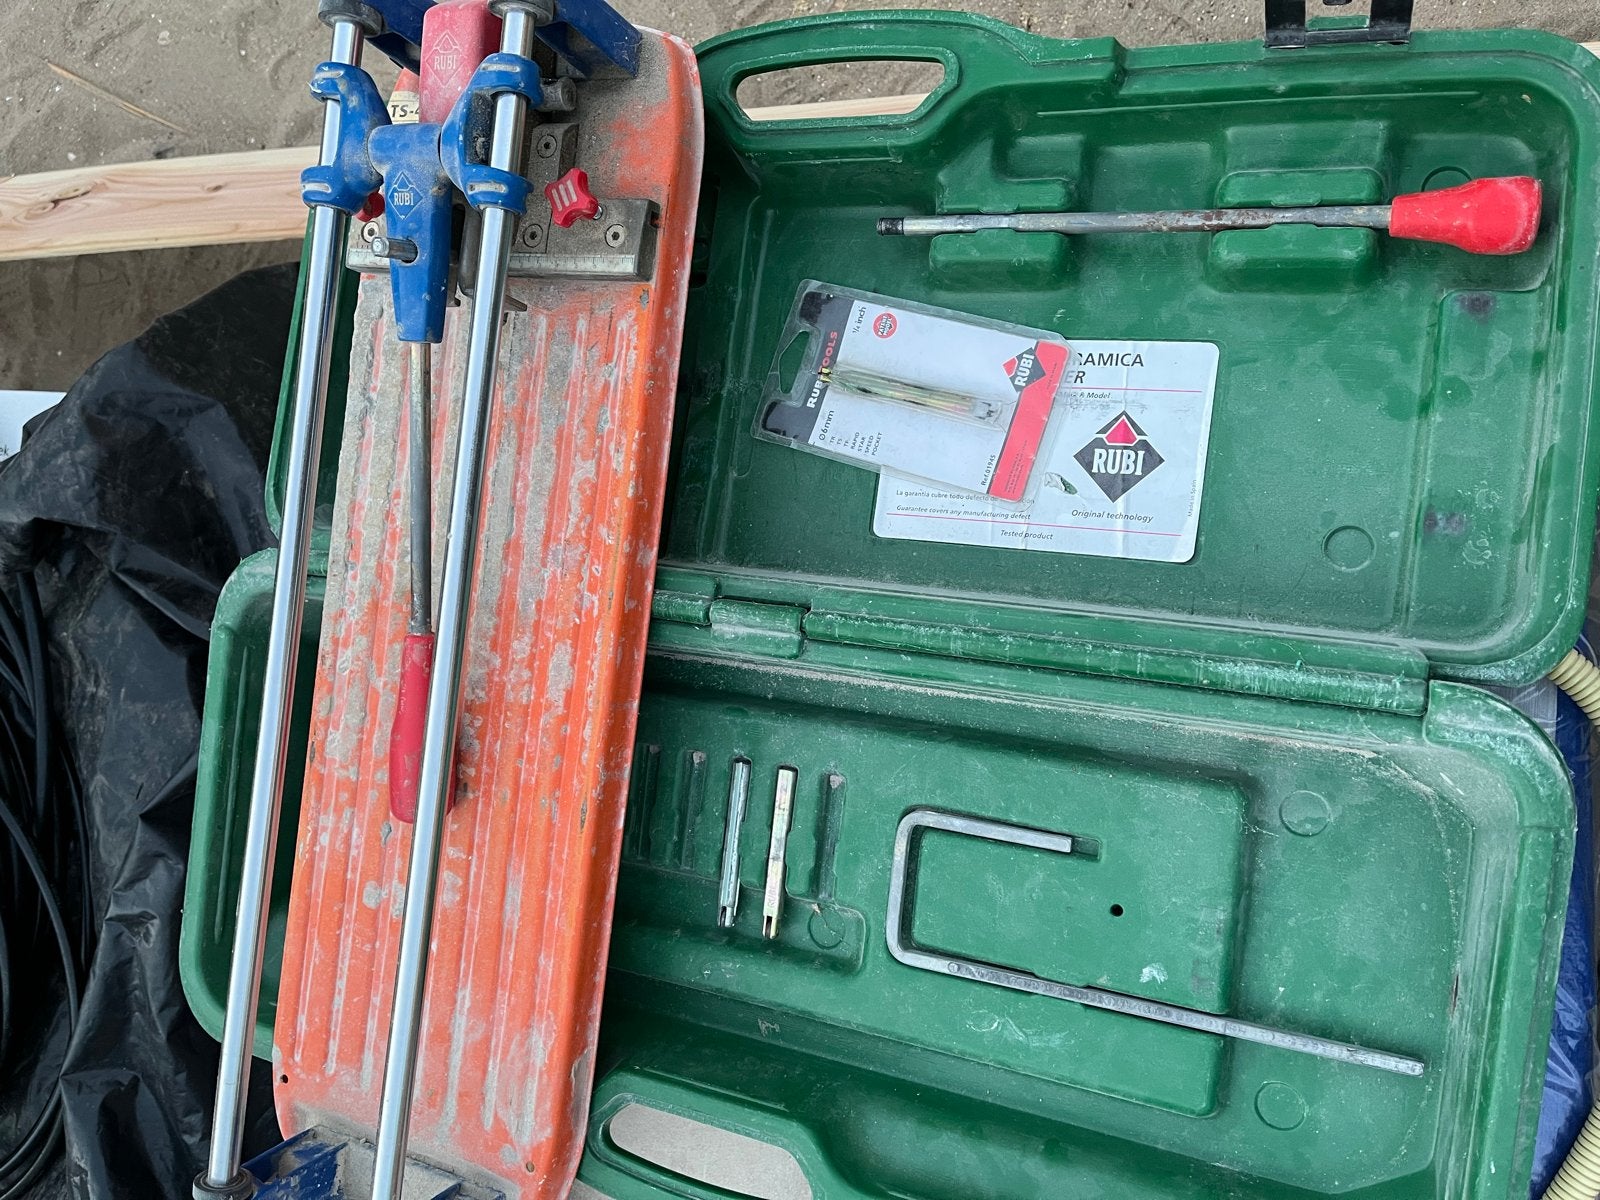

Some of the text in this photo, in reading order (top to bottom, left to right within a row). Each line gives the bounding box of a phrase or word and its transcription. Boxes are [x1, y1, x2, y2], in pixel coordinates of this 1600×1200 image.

[434, 54, 457, 70] RUBI
[393, 192, 414, 206] RUBI
[857, 305, 867, 324] inch
[1014, 353, 1035, 387] RUBI
[806, 376, 823, 408] RUB
[850, 432, 860, 450] RAPID
[857, 436, 866, 452] STAR
[864, 435, 874, 453] SPEED
[871, 432, 883, 456] POCKET
[980, 454, 996, 486] Ref.01945
[1091, 448, 1145, 476] RUBI
[1189, 478, 1198, 494] Spain
[931, 491, 948, 499] cubre
[896, 504, 928, 513] Guarantee
[949, 509, 962, 517] any
[962, 509, 1009, 520] manufacturing
[1010, 512, 1031, 520] defect
[1071, 509, 1154, 524] Original technology
[1186, 501, 1194, 517] Made
[1000, 530, 1054, 540] Tested product
